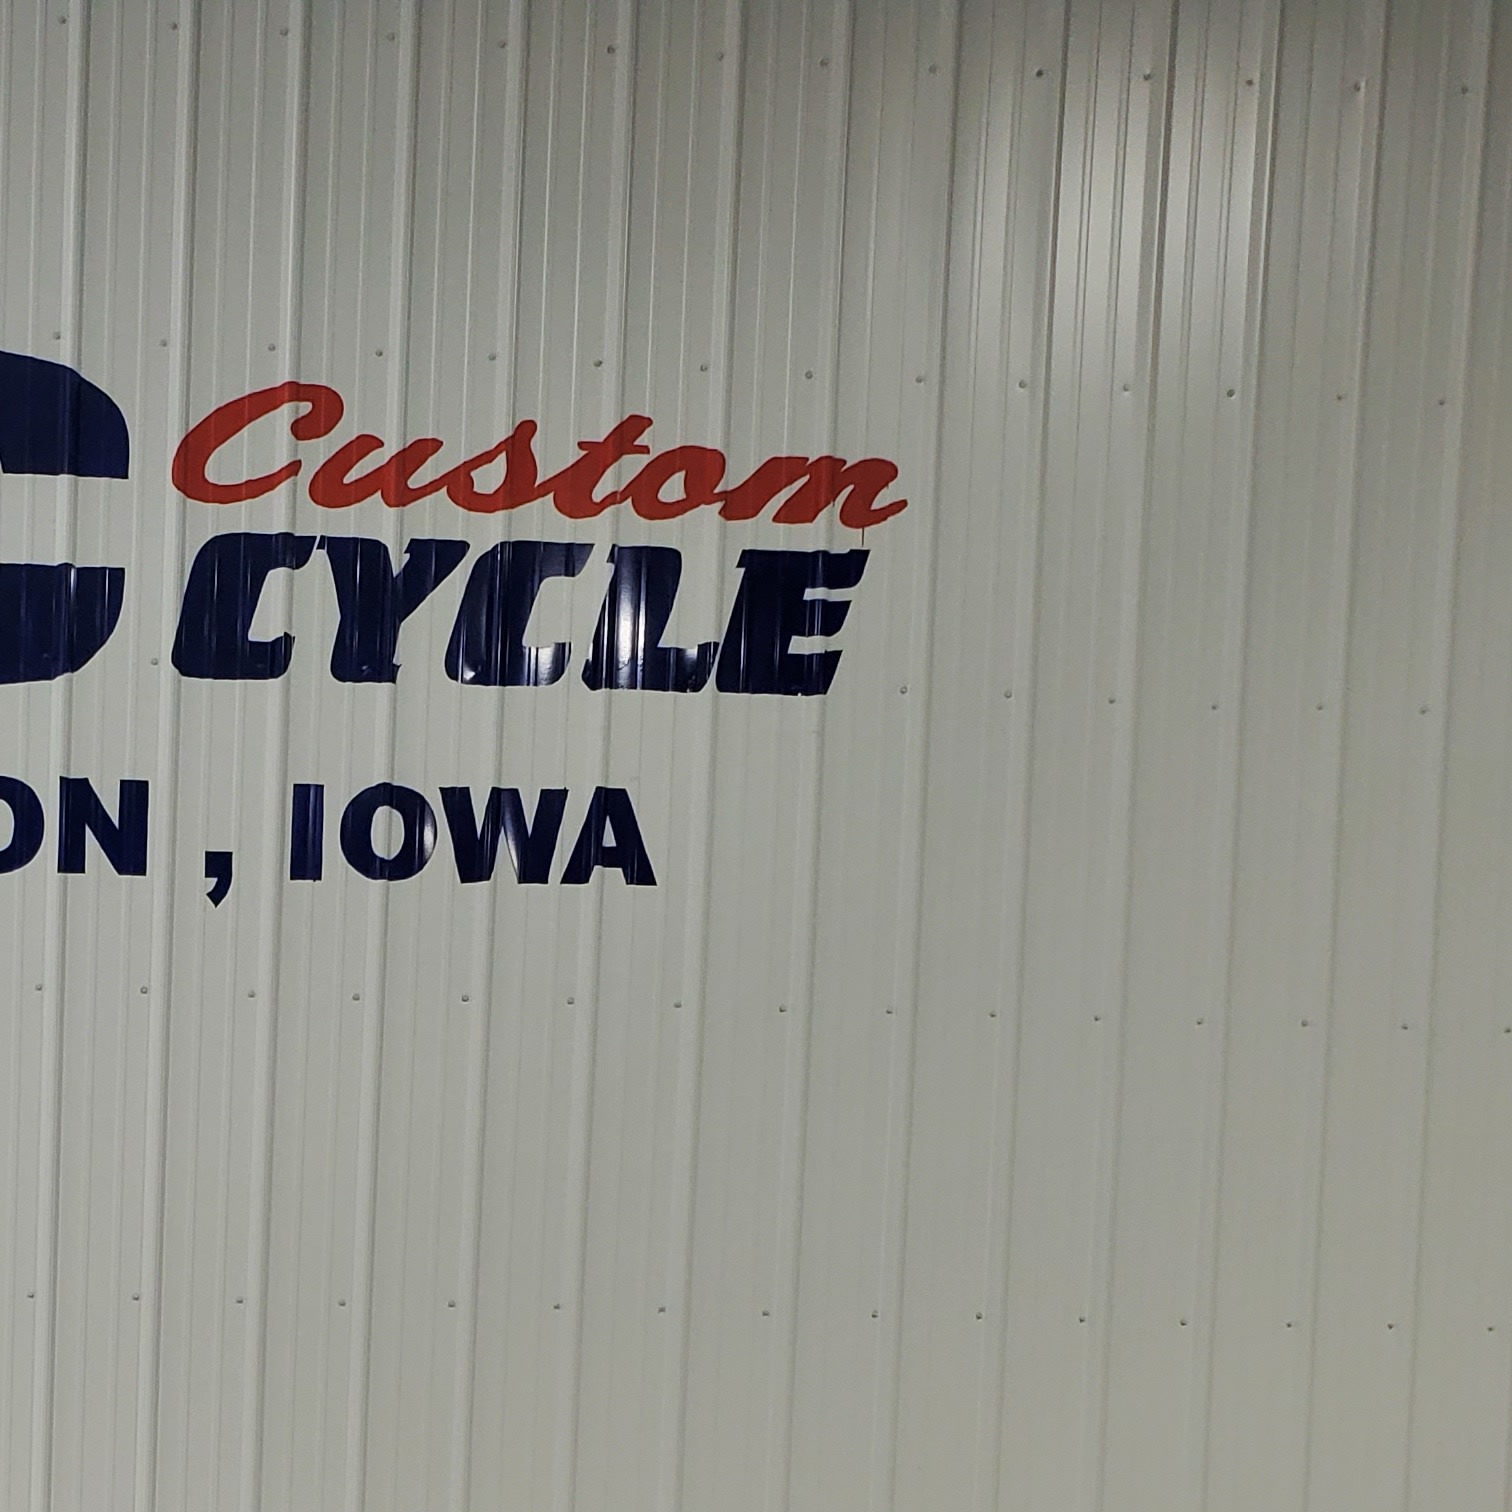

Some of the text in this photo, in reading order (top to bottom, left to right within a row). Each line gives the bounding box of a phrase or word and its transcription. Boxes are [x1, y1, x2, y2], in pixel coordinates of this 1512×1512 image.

[171, 381, 908, 529] Custom
[170, 531, 871, 697] CYCLE
[289, 781, 658, 887] IOWA
